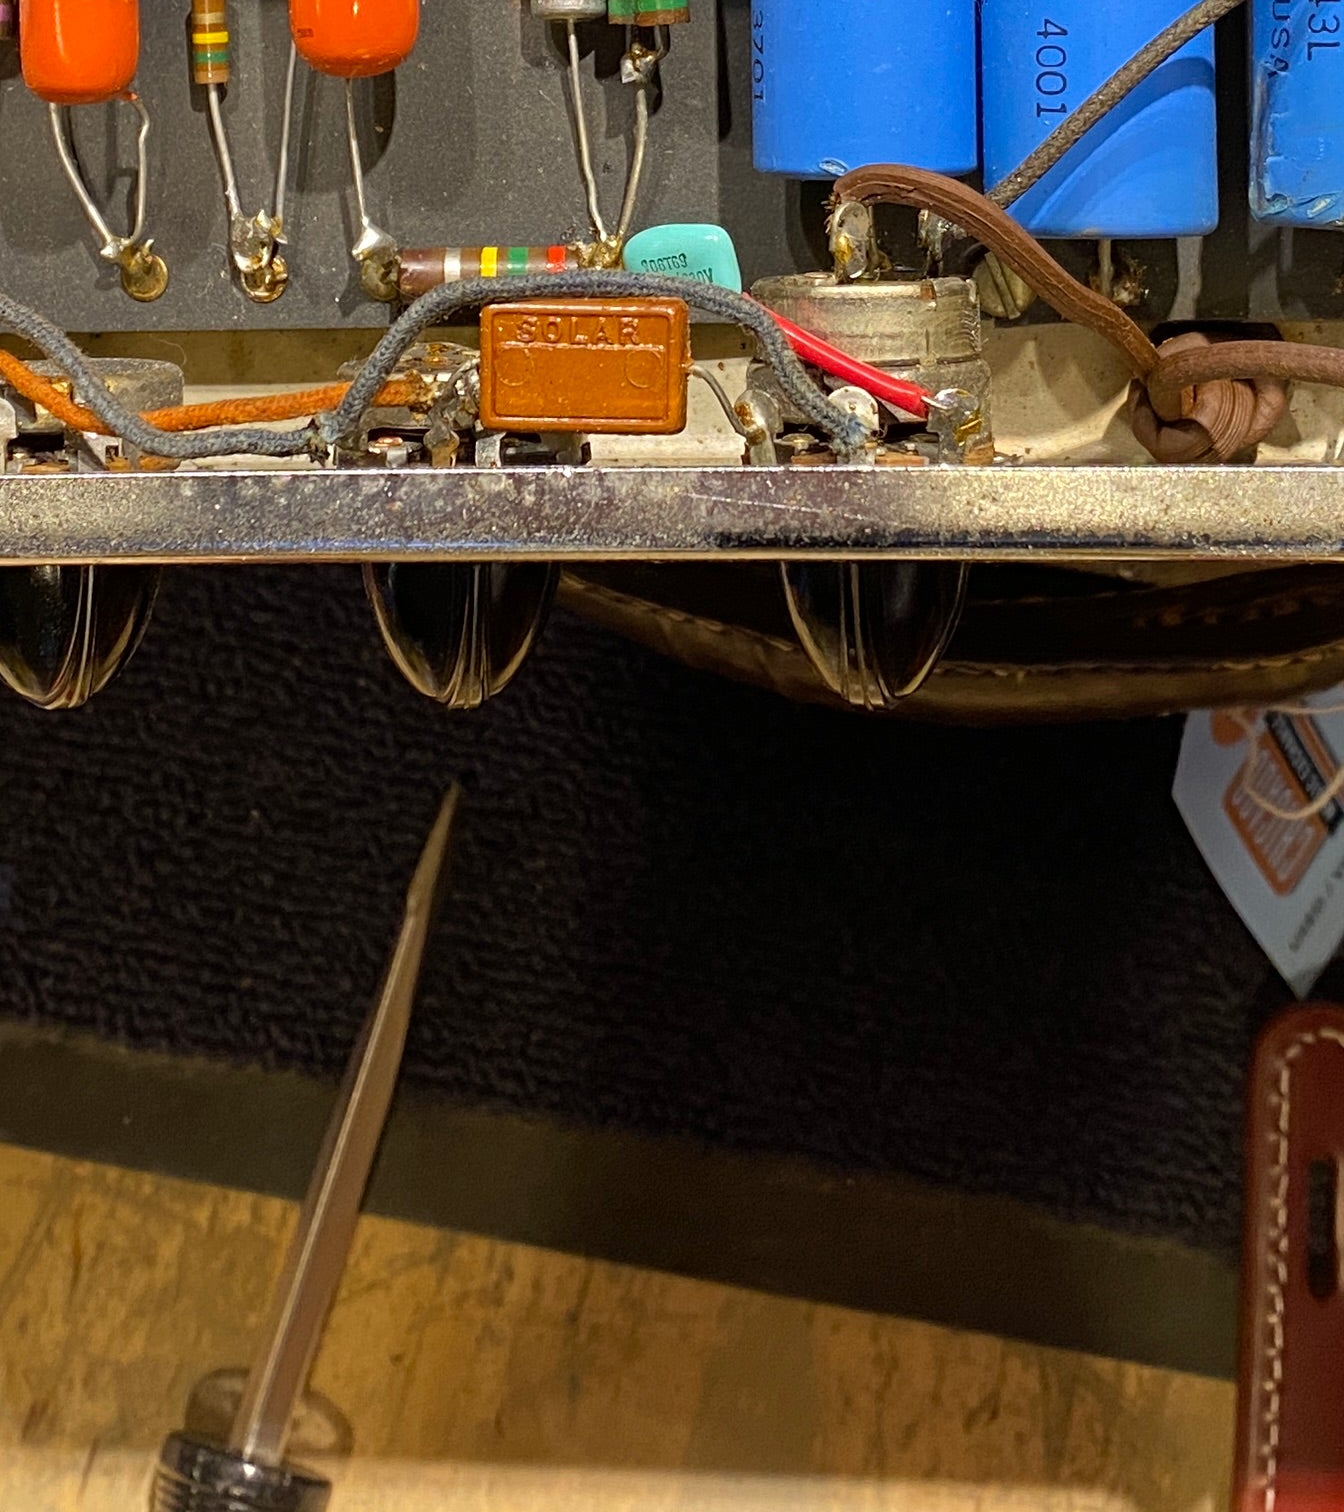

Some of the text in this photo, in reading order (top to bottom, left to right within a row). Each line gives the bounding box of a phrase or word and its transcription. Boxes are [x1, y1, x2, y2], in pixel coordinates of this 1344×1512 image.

[752, 10, 766, 103] 3701
[1035, 18, 1068, 119] 4001
[515, 316, 640, 346] SOLAR
